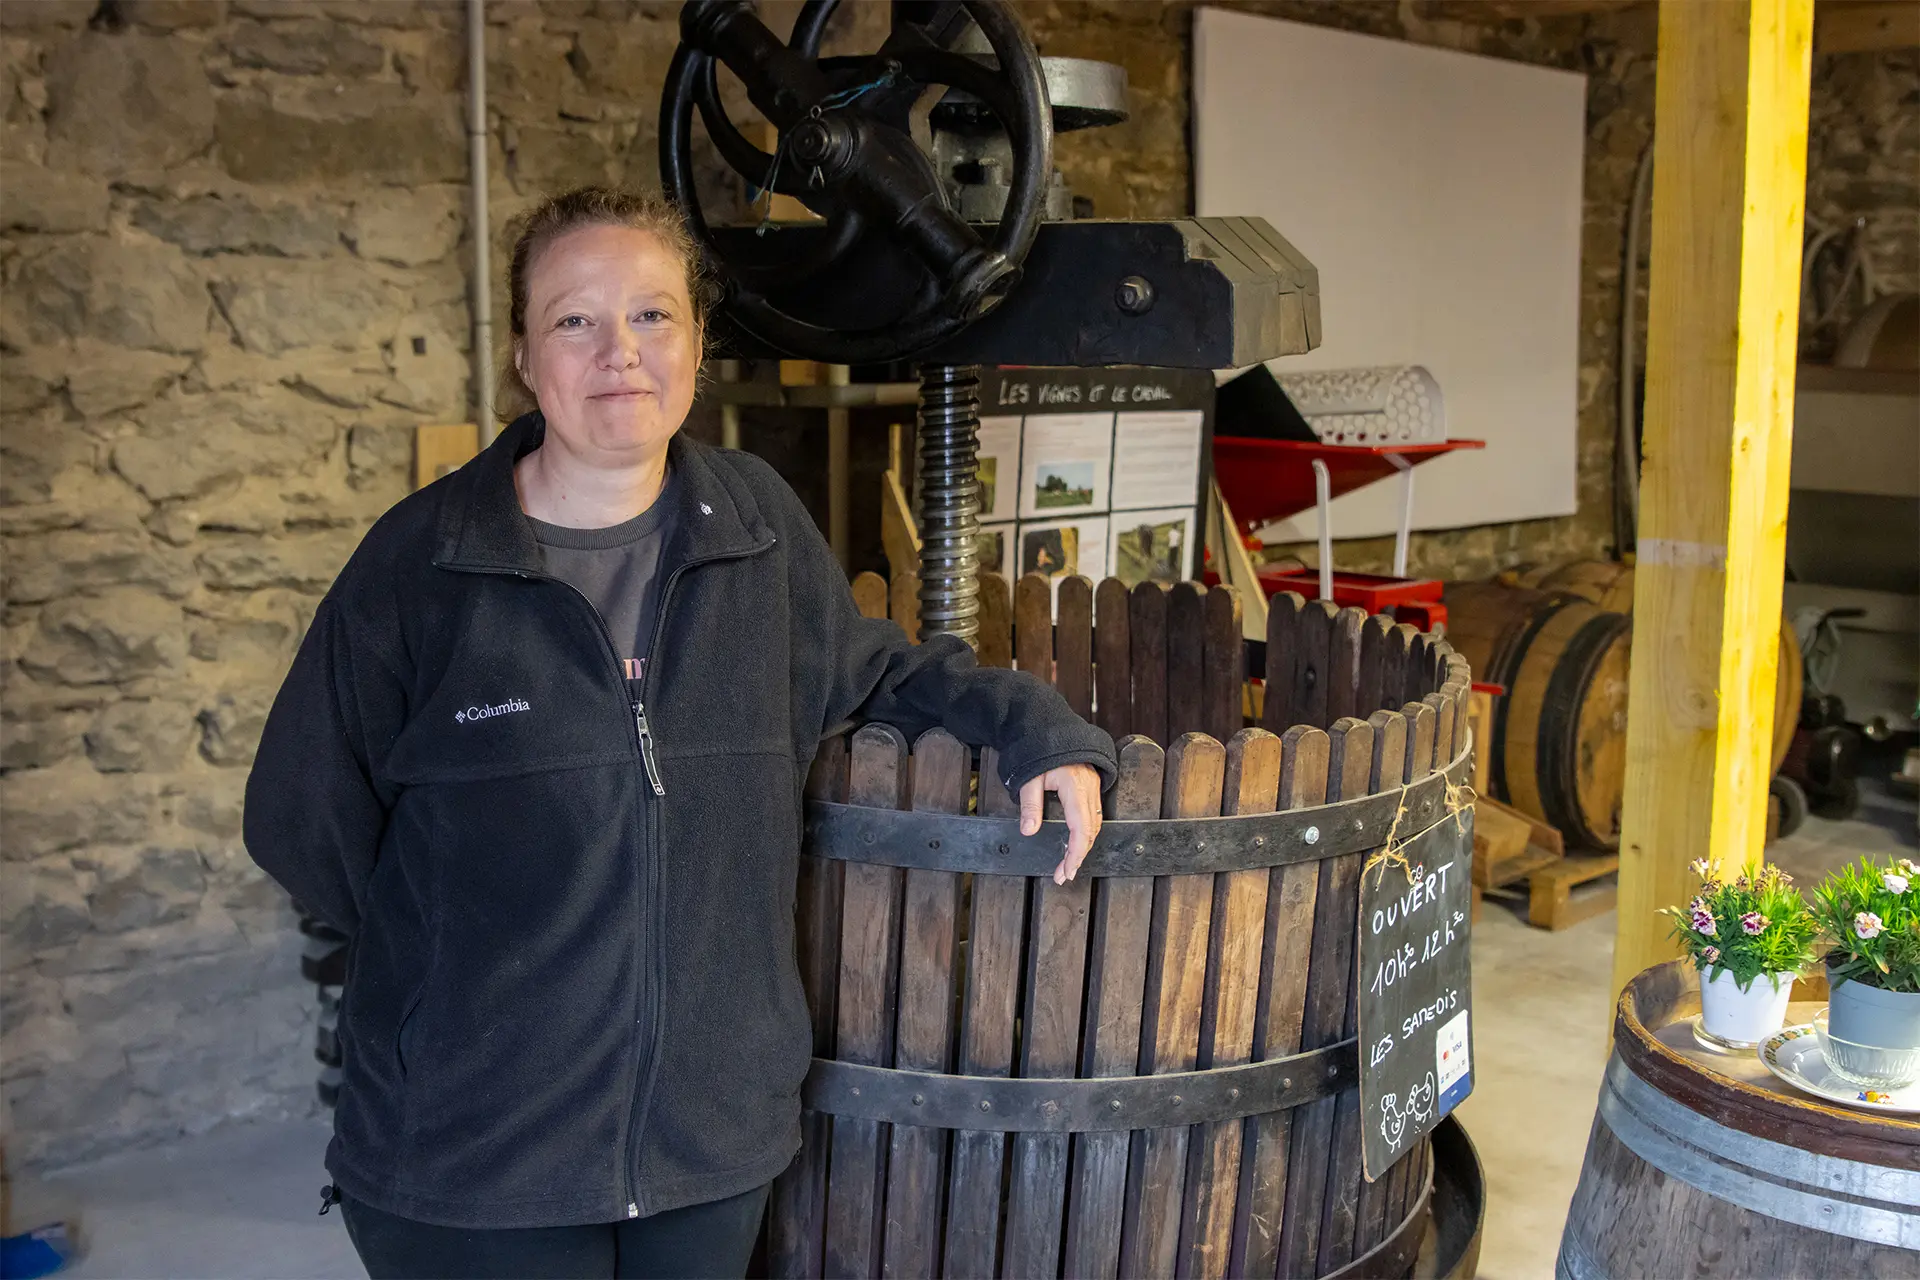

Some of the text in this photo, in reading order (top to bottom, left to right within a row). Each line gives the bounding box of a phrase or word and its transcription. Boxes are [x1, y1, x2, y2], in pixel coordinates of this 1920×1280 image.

[998, 377, 1031, 405] LES
[1038, 383, 1082, 405] VIGNES
[1088, 383, 1107, 403] ET
[1110, 384, 1129, 403] LE
[466, 698, 531, 721] Columbia
[1372, 861, 1454, 935] OUVERT
[1370, 1033, 1394, 1068] LES
